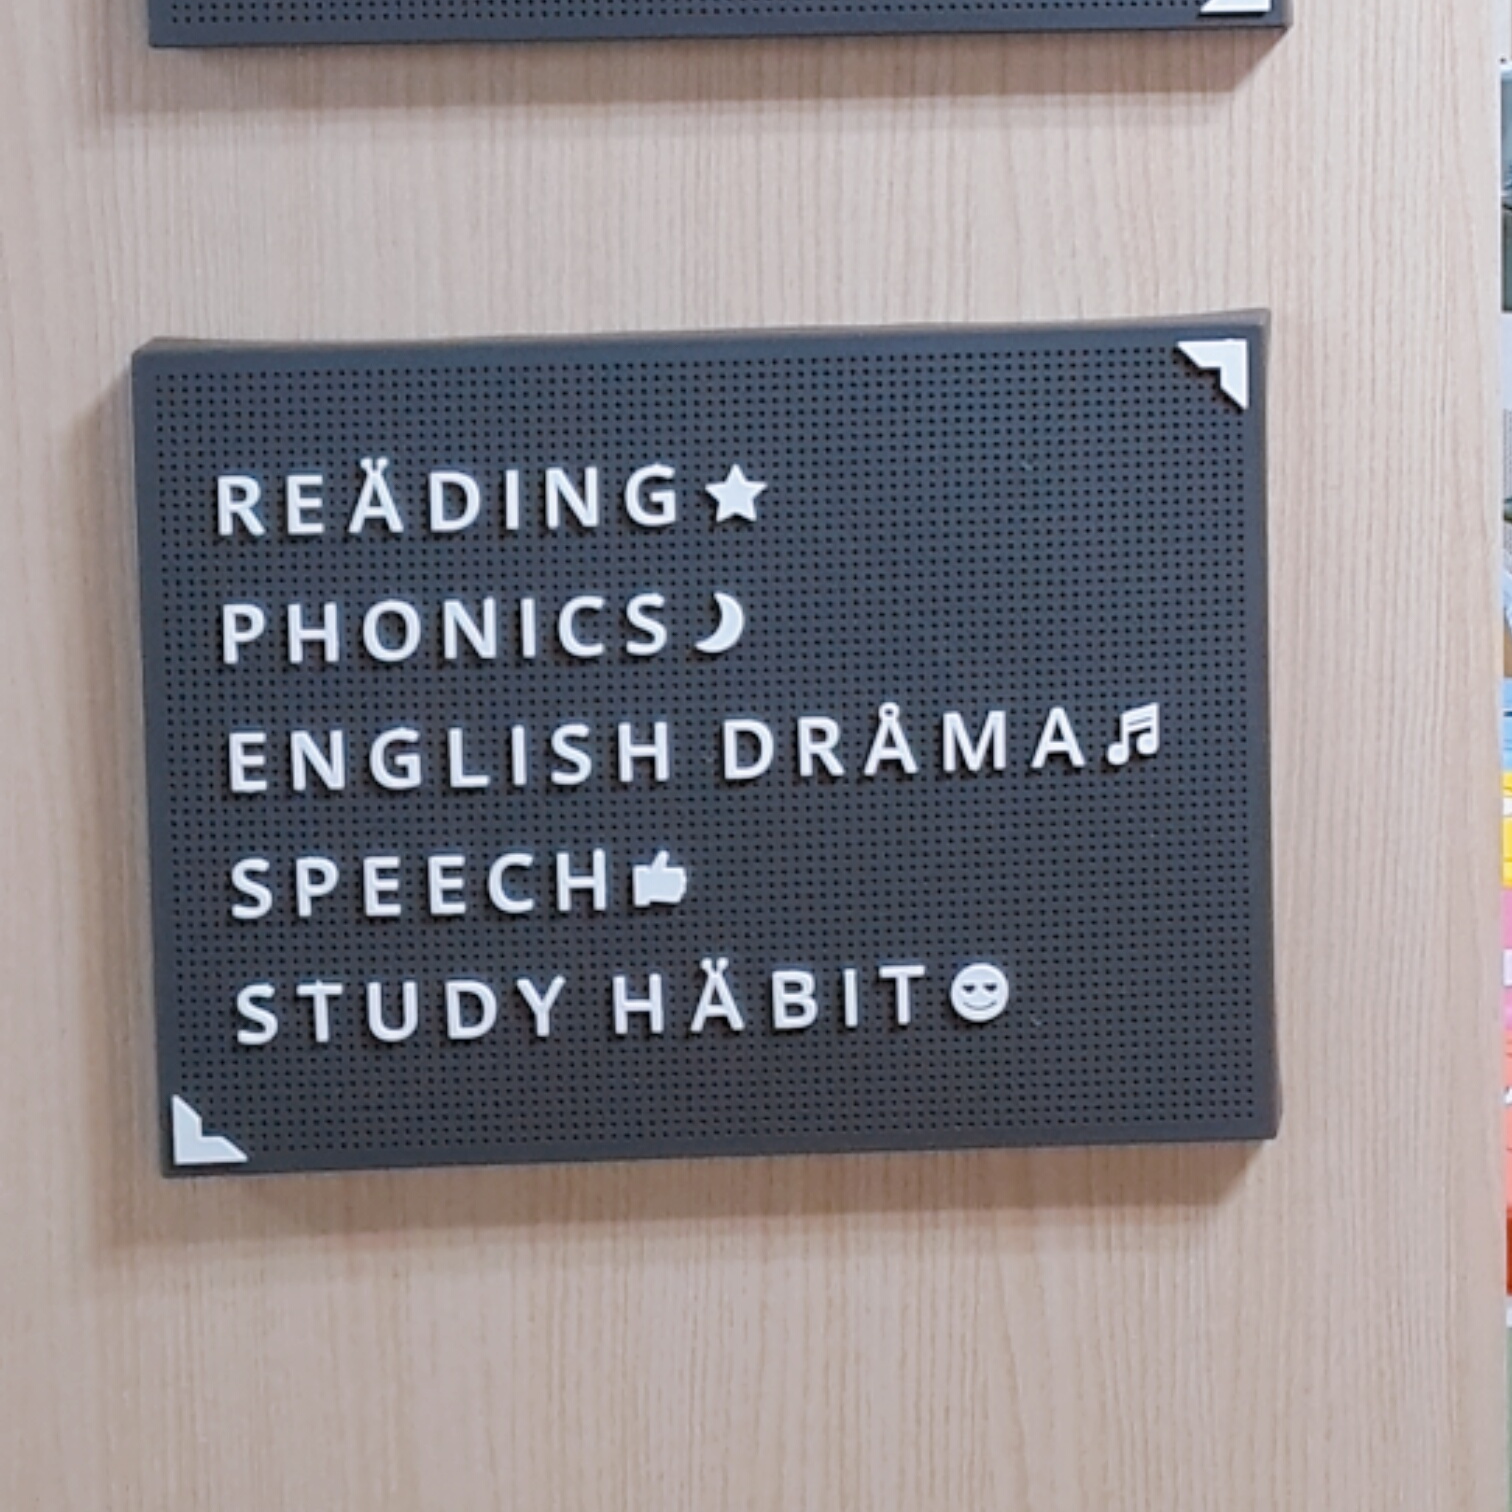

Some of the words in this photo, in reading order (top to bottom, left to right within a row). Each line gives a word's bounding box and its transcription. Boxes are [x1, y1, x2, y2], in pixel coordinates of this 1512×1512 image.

[222, 591, 669, 665] PHONICS
[228, 720, 671, 793] ENGLISH
[231, 847, 608, 920] SPEECH
[236, 974, 567, 1045] STUDY
